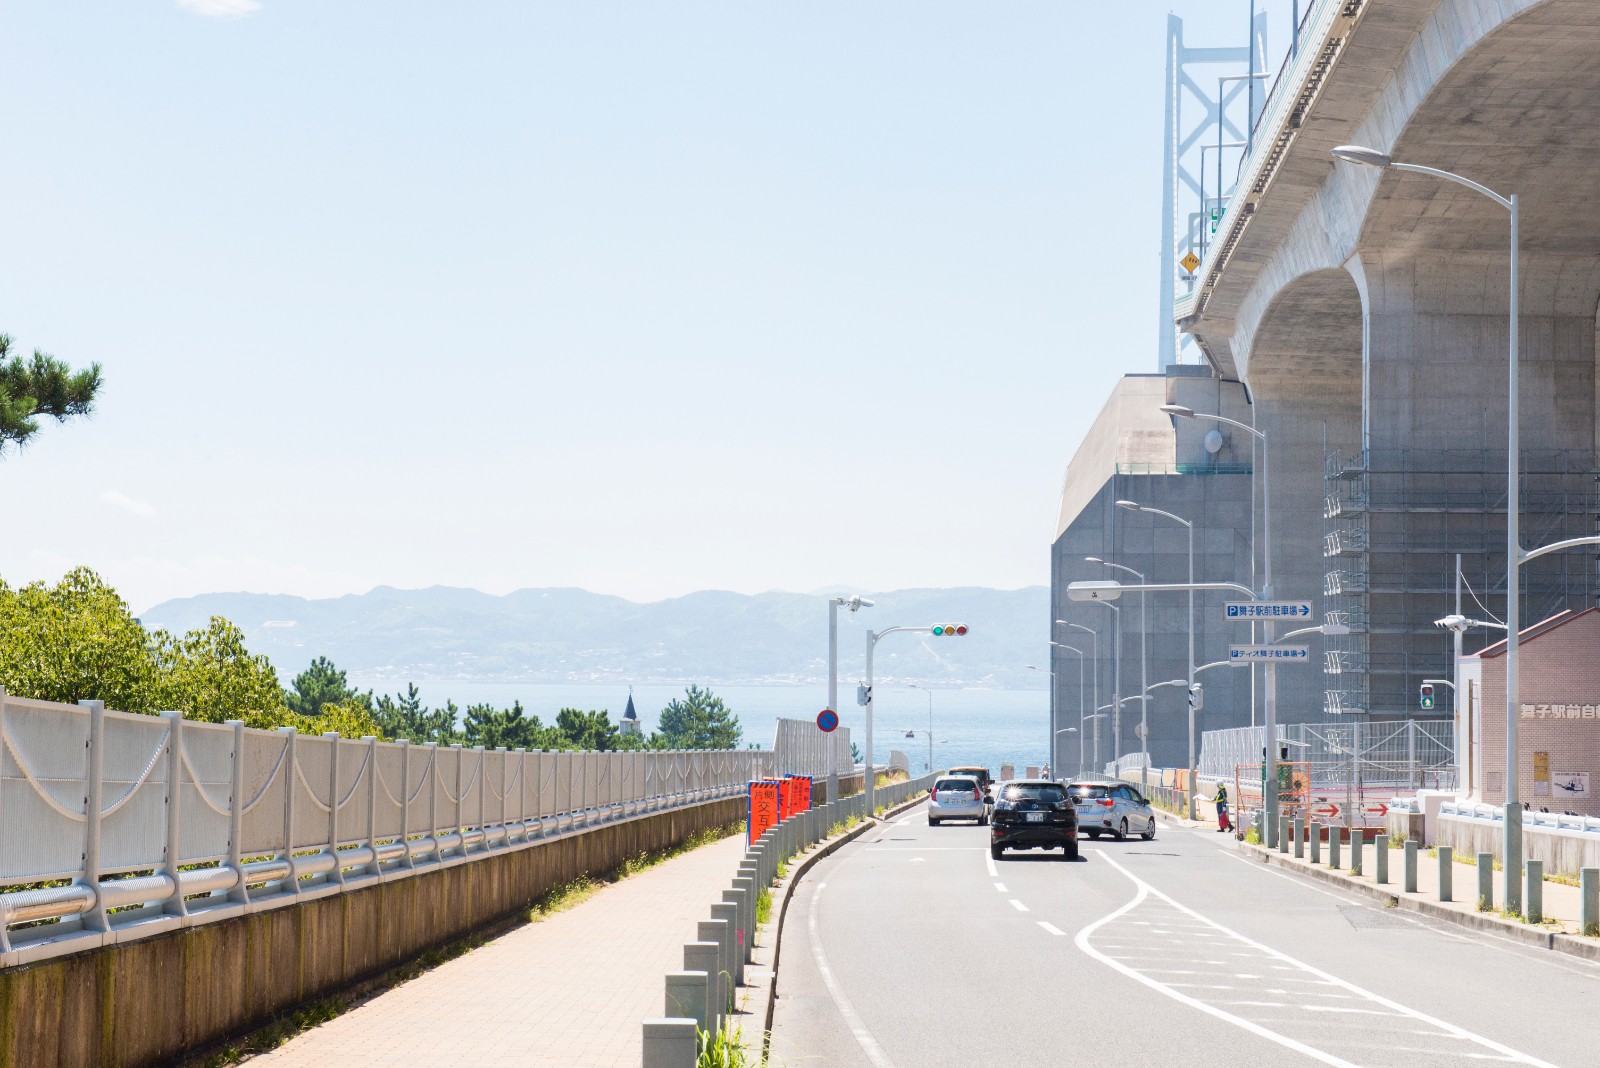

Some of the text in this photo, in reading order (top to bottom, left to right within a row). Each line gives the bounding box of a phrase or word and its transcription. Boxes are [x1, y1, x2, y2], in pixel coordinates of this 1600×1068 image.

[1229, 605, 1298, 616] P 舞子駅前駐車場
[1520, 704, 1600, 719] 舞子駅前自
[754, 790, 775, 800] 片側
